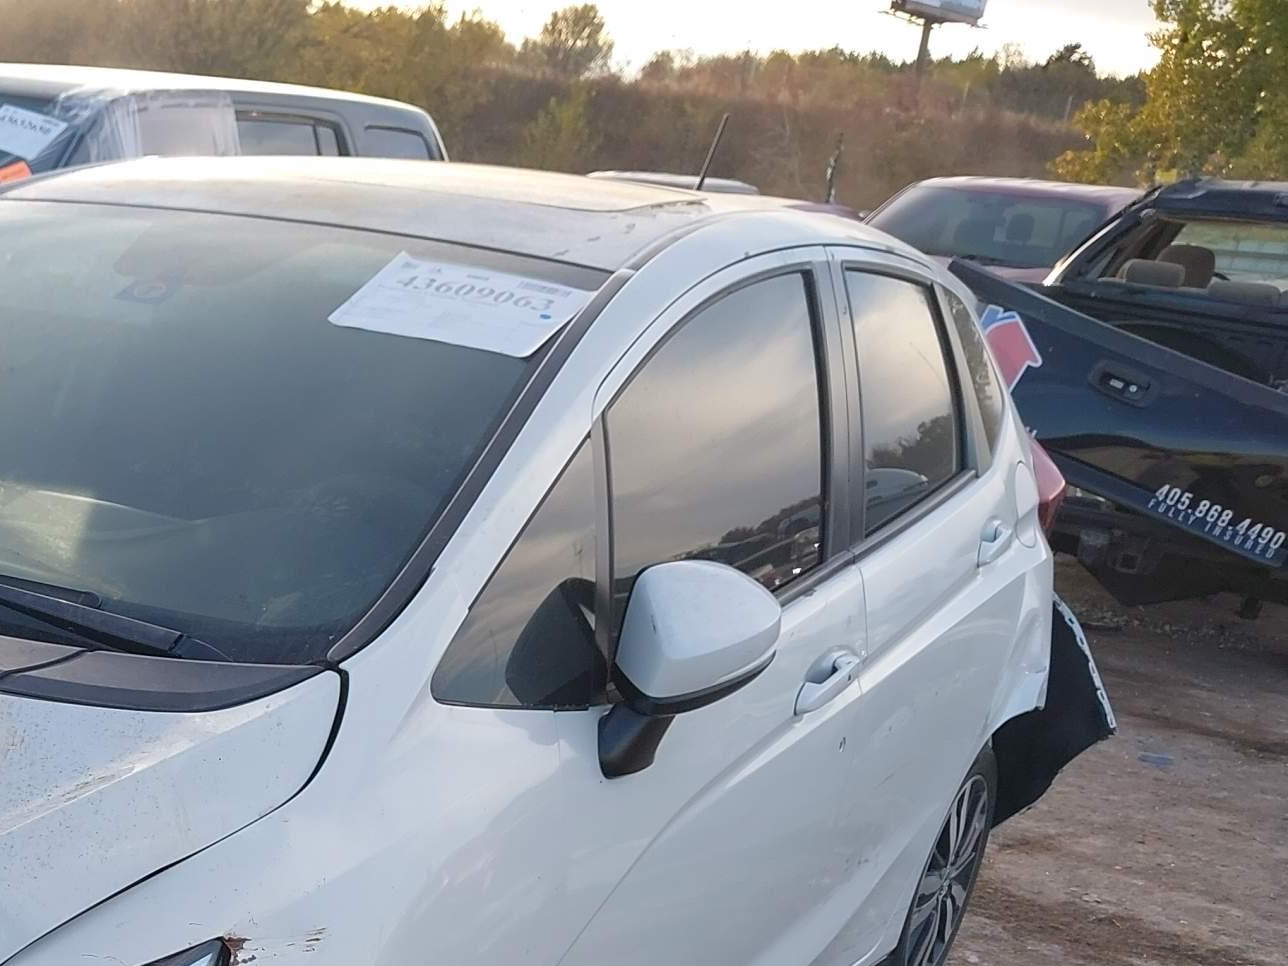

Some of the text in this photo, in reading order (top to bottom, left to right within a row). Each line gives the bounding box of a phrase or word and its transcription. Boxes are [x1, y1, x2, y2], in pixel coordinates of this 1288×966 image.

[397, 275, 555, 311] 43609063
[1148, 498, 1274, 558] FULLY INSURED
[1155, 484, 1286, 549] 405.868.4490
